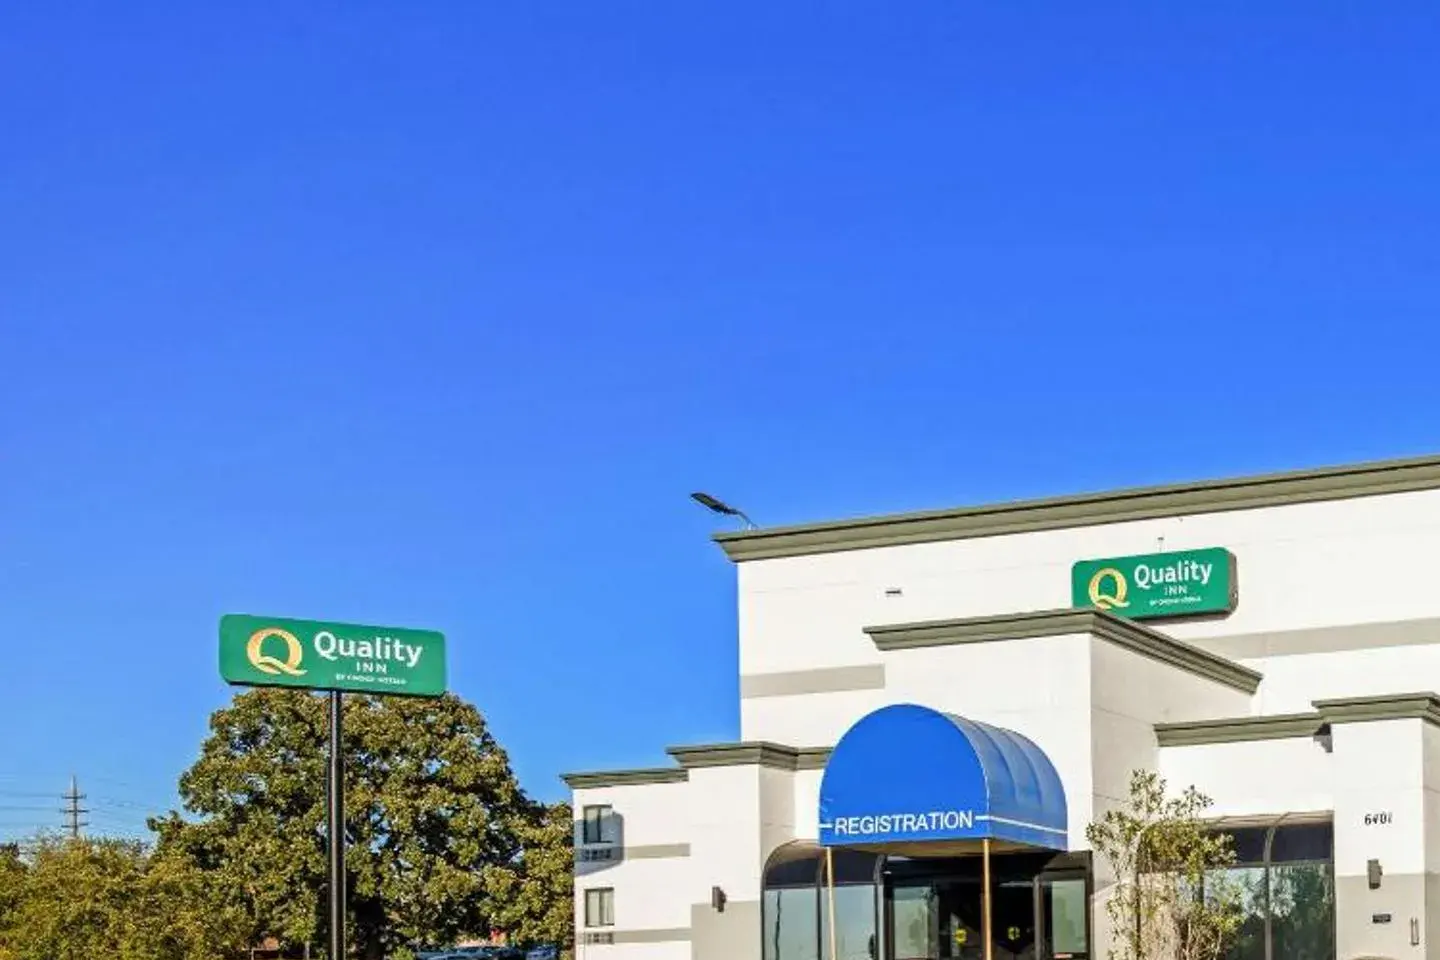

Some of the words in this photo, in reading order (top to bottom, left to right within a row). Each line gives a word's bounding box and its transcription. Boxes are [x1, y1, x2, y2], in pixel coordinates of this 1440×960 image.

[1134, 560, 1213, 589] Quality
[1164, 584, 1188, 596] INN
[314, 631, 423, 667] Quality
[356, 661, 387, 675] INN
[834, 810, 972, 835] REGISTRATION
